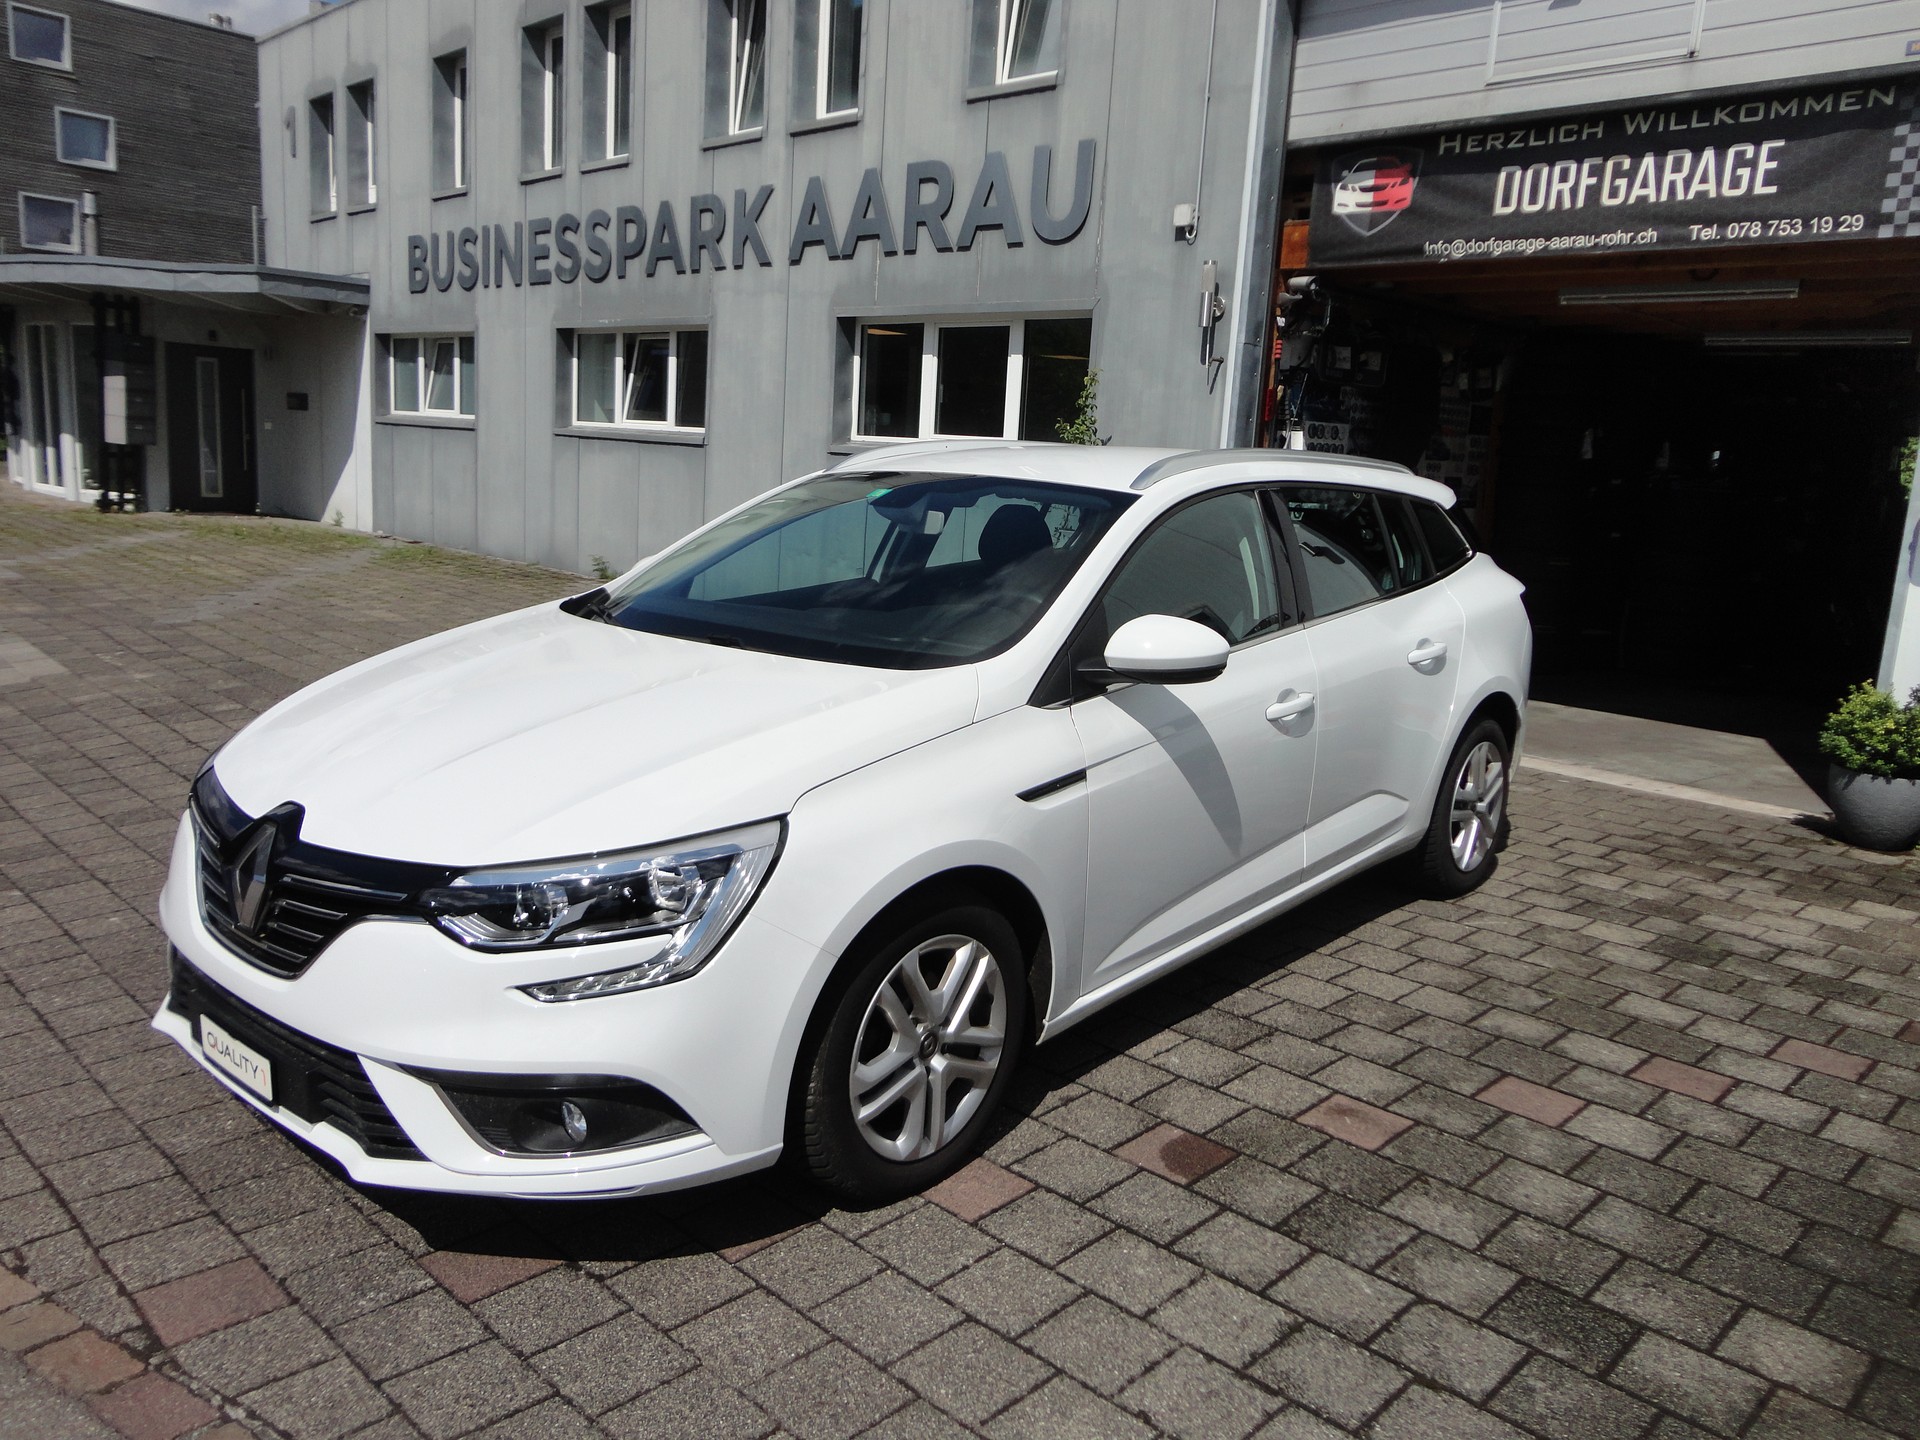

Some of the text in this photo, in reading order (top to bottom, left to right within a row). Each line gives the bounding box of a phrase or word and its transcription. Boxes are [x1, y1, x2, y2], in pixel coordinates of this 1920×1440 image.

[1438, 85, 1897, 156] HERZLICH WILLKOMMEN
[1492, 138, 1787, 218] DORFGARAGE
[408, 139, 1098, 294] BUSINESSPARK AARAU
[1689, 222, 1722, 241] Tel.
[1727, 220, 1764, 239] 078
[1766, 218, 1804, 237] 753
[1809, 216, 1833, 235] 19
[1837, 213, 1865, 233] 29
[206, 1031, 259, 1080] QUALITY
